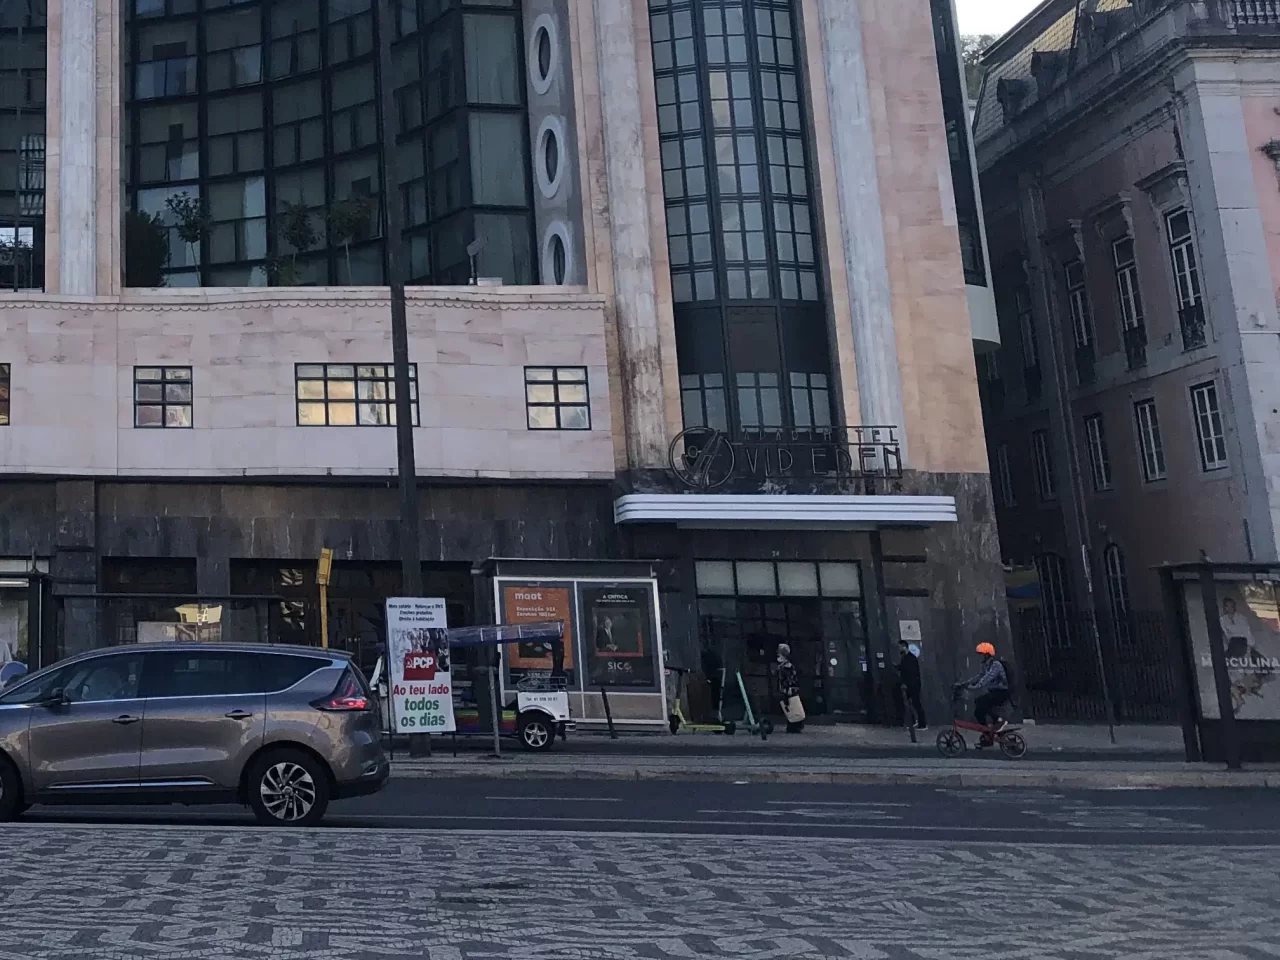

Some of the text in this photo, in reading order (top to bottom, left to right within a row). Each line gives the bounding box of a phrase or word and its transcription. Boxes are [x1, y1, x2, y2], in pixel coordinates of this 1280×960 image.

[746, 446, 903, 476] VIP EDEN
[515, 592, 543, 600] maat
[413, 656, 434, 669] PCP
[393, 684, 450, 696] Ao teu lado
[404, 697, 440, 711] todos
[400, 712, 446, 727] os dias
